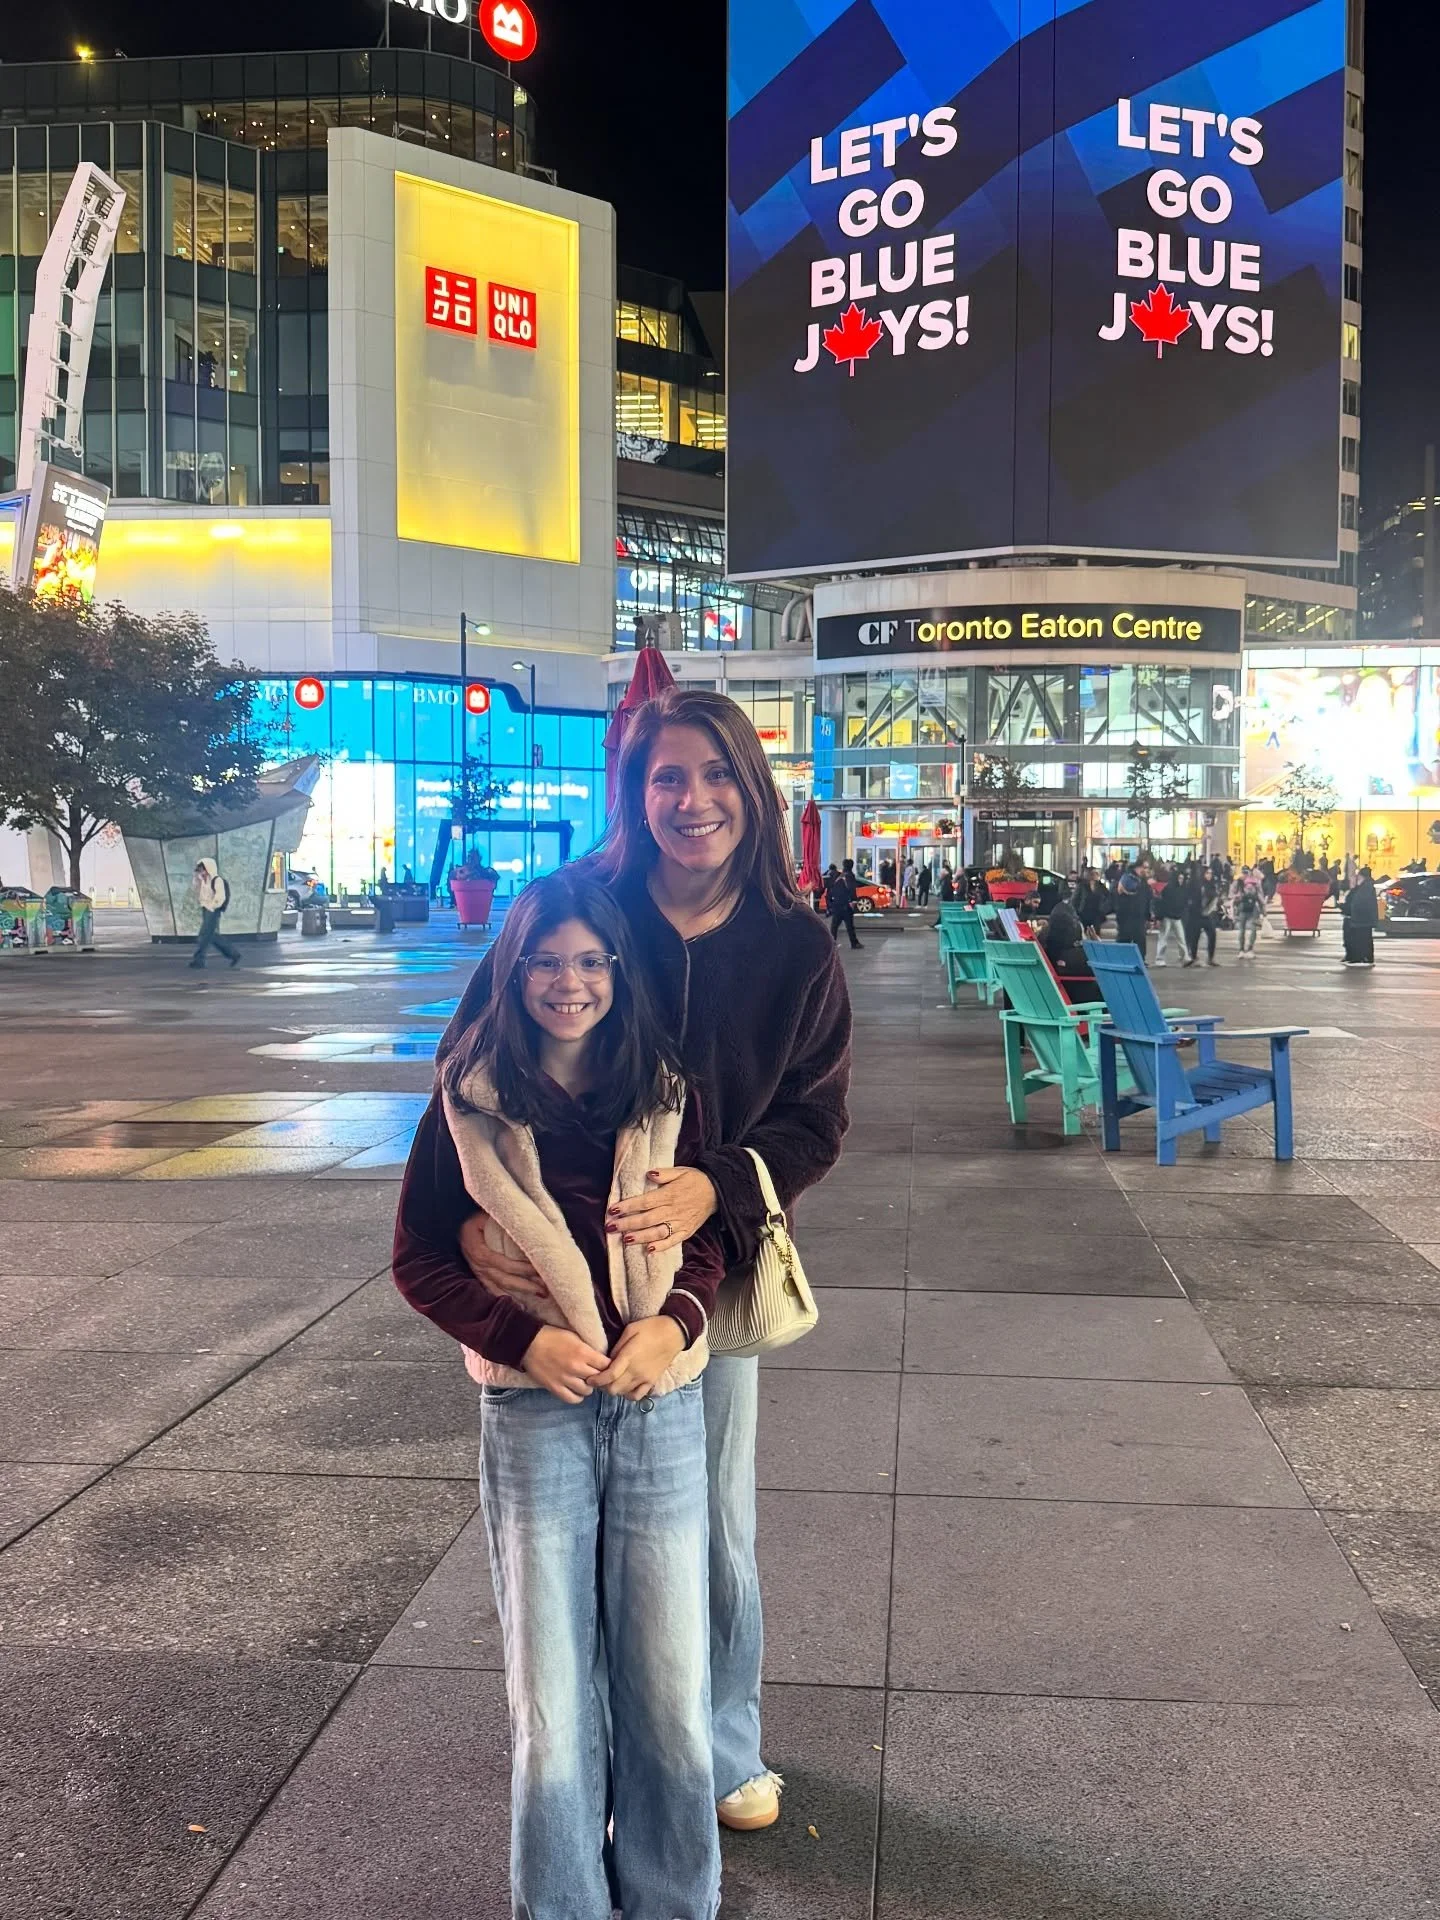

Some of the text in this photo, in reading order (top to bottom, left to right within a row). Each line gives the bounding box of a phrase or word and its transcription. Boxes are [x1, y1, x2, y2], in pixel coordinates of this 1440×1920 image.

[811, 106, 958, 184] LET'S
[1117, 98, 1264, 166] LET'S
[838, 178, 925, 238] GO
[1147, 169, 1233, 224] GO
[811, 233, 955, 308] BLUE
[1117, 228, 1261, 292] BLUE
[493, 289, 529, 318] UNI
[493, 313, 532, 341] QLO
[858, 612, 1202, 646] CF Toronto Eaton Centre
[413, 687, 459, 705] BMO
